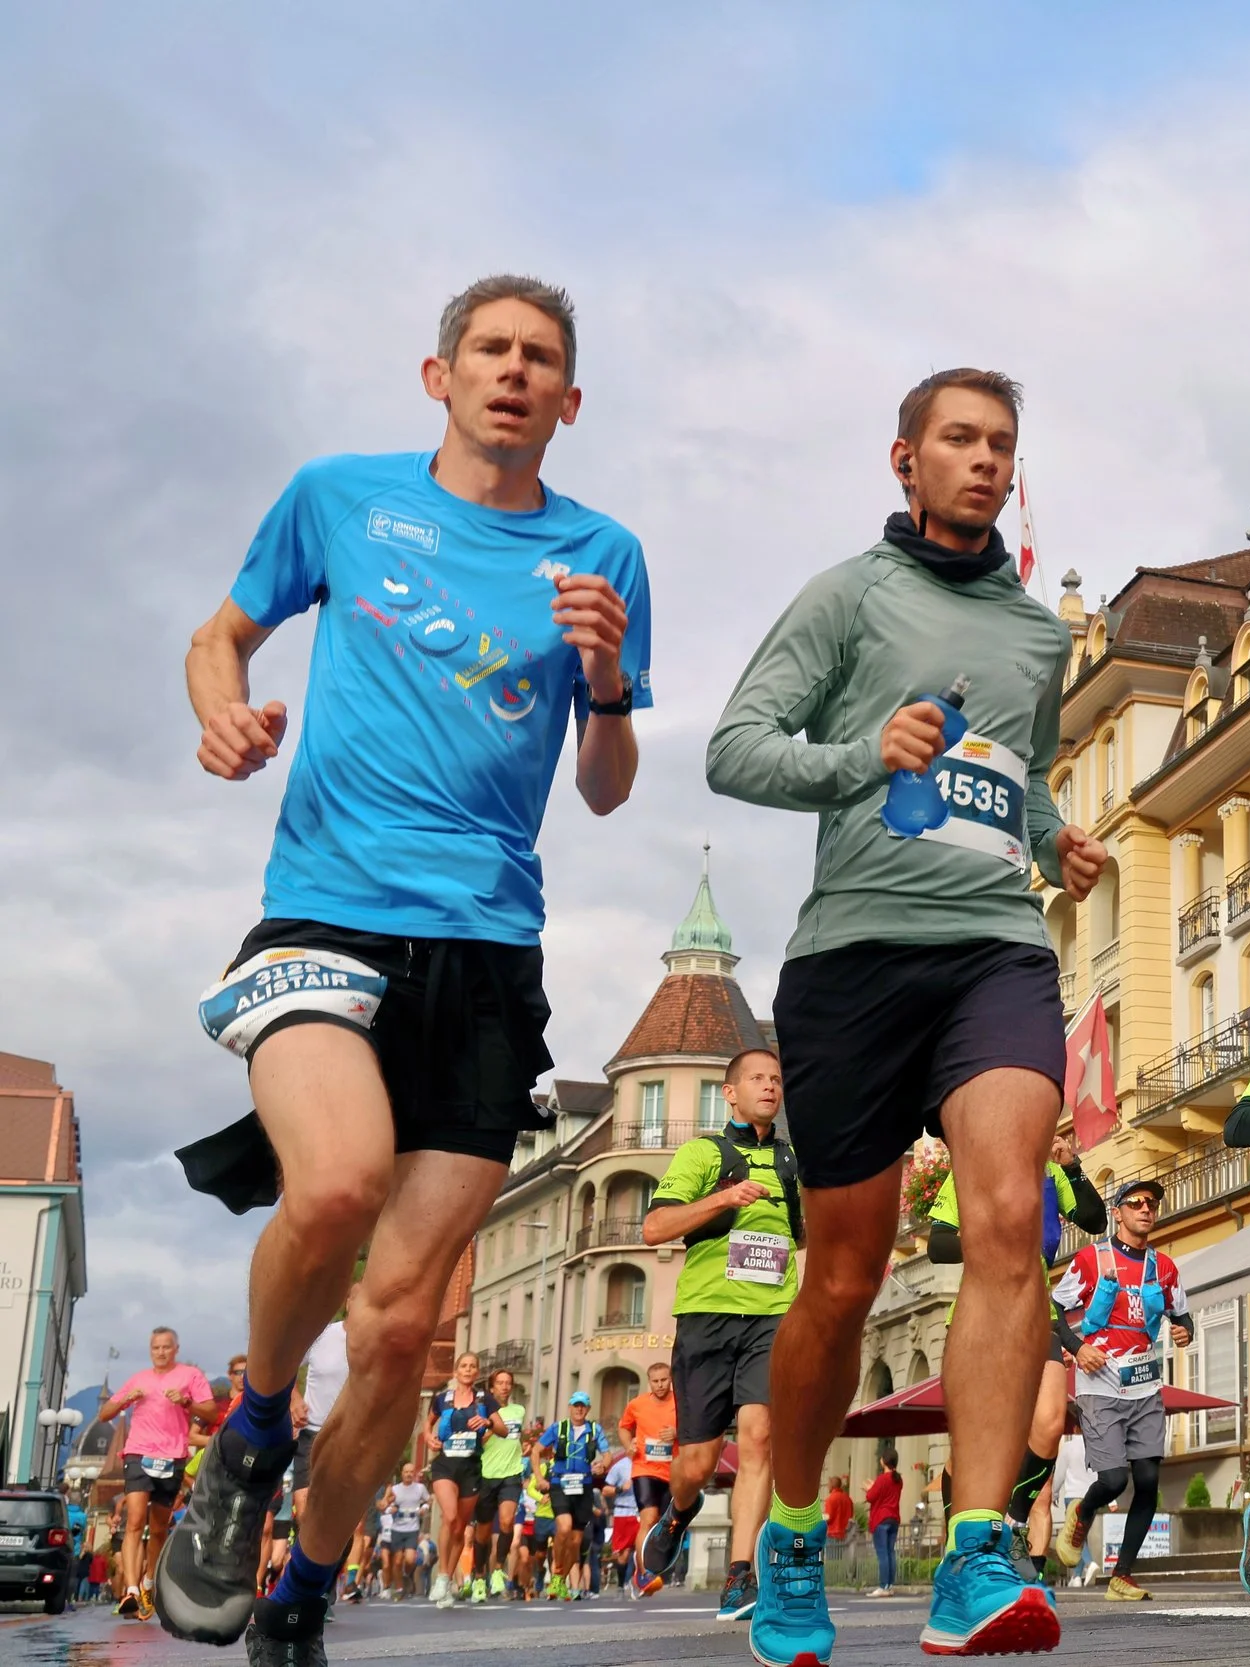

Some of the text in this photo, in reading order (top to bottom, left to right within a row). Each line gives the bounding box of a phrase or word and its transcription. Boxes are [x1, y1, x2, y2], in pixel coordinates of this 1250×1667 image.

[934, 769, 1009, 818] 4535
[236, 972, 349, 1015] ALISTAIR
[743, 1234, 773, 1245] CRAFT
[750, 1247, 773, 1259] 1690
[743, 1258, 777, 1270] ADRIAN
[1127, 1356, 1148, 1365] CRAFT
[1131, 1371, 1153, 1384] RAZVAN
